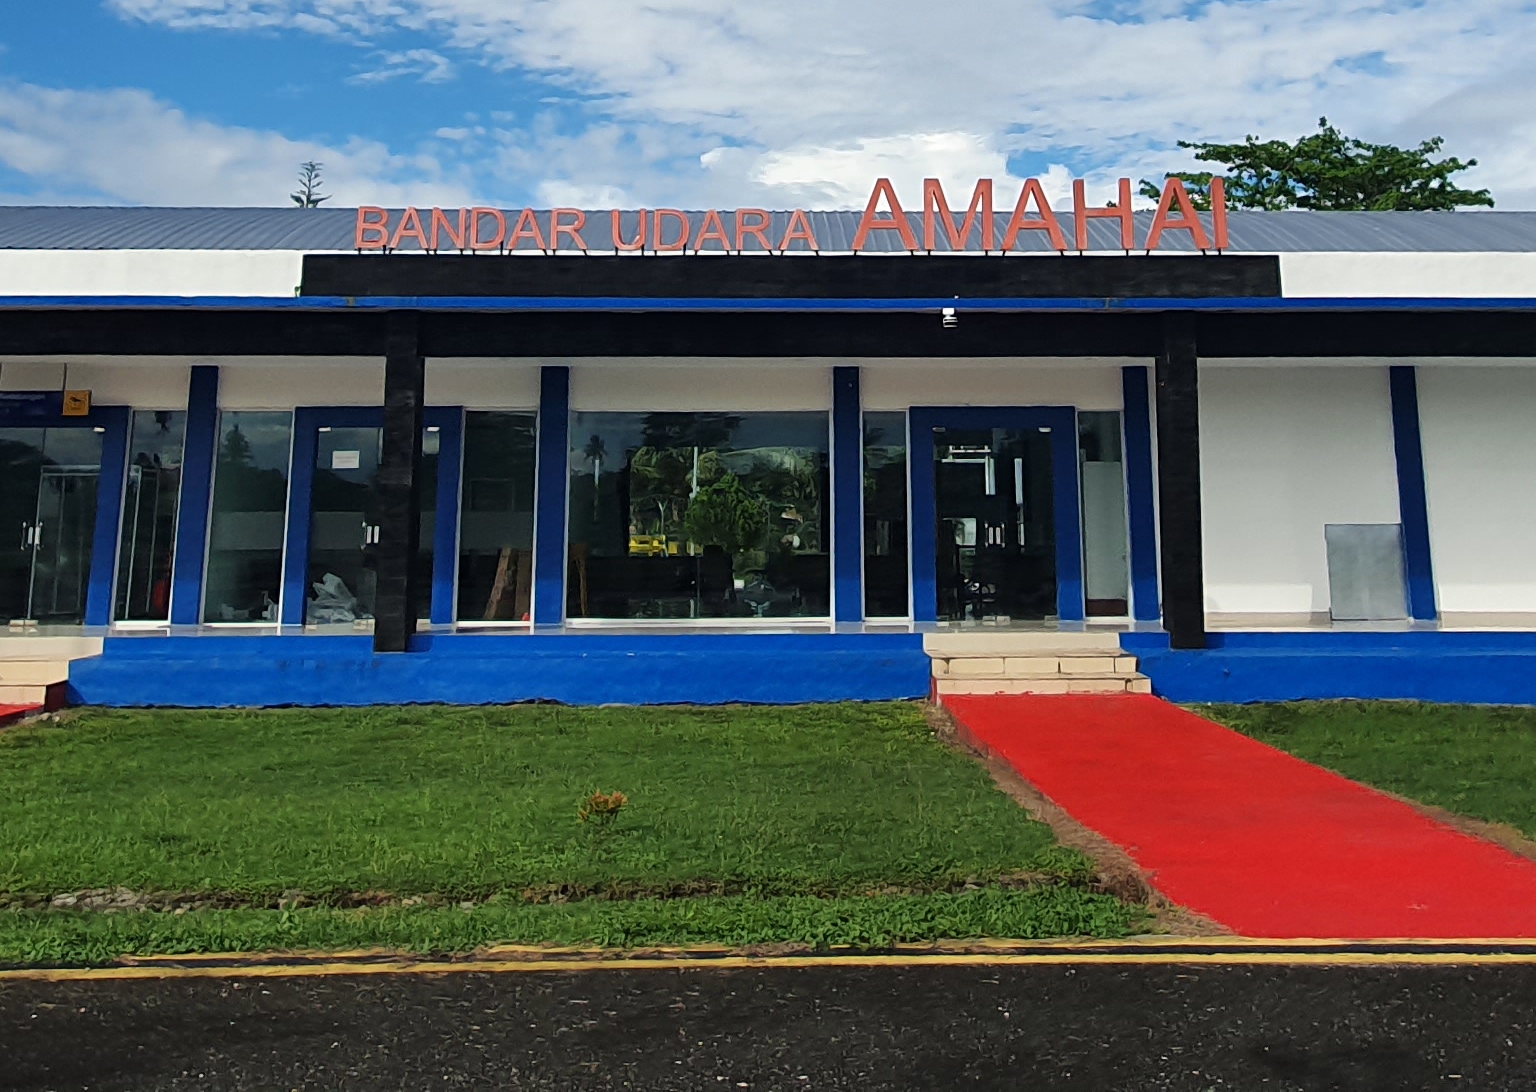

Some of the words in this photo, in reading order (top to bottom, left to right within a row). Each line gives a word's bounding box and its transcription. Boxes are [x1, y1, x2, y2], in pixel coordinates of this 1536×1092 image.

[355, 206, 587, 249] BANDAR
[612, 208, 819, 251] UDARA
[852, 177, 1228, 250] AMAHAI
